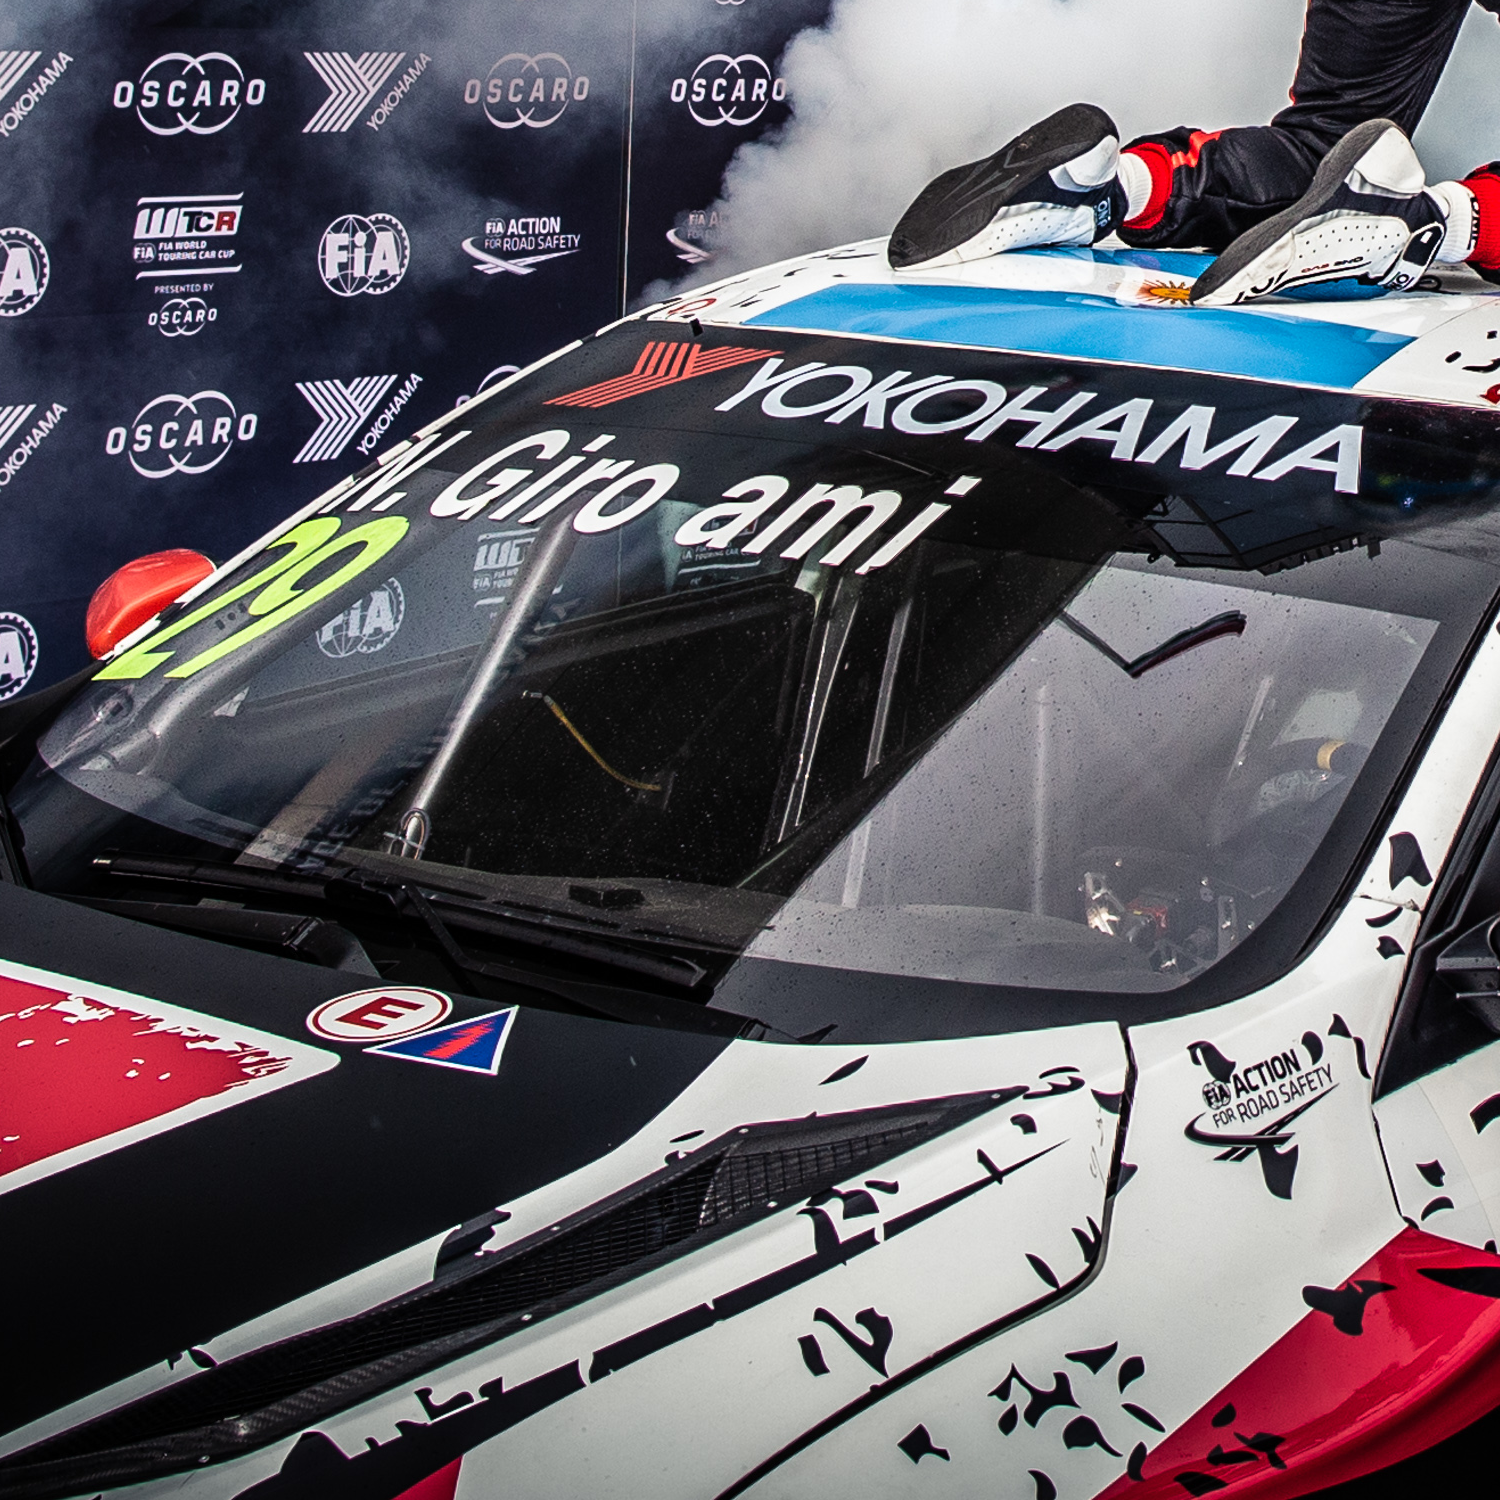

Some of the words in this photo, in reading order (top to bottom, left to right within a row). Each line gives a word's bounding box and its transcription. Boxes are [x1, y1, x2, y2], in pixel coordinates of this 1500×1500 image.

[113, 78, 267, 108] OSCARO
[365, 51, 433, 132] YOKOHAMA
[464, 76, 590, 105] OSCARO
[670, 77, 787, 102] OSCARO
[133, 205, 243, 239] WTCR
[507, 216, 561, 236] ACTION
[158, 242, 173, 252] FIA
[174, 240, 207, 251] WORLD
[158, 251, 197, 261] TOURING
[198, 250, 216, 260] CAR
[218, 248, 236, 259] CUP
[484, 237, 502, 250] FOR
[503, 236, 536, 252] ROAD
[537, 233, 581, 251] SAFETY
[154, 284, 201, 294] PRESENTED
[203, 283, 215, 292] BY
[148, 307, 218, 326] OSCARO
[356, 372, 423, 456] YOKOHAMA
[714, 358, 1365, 495] YOKOHAMA
[105, 412, 258, 457] OSCARO
[90, 515, 411, 682] 29
[1233, 1047, 1302, 1097] ACTION
[1212, 1106, 1236, 1129] FOR
[1236, 1090, 1282, 1122] ROAD
[1280, 1063, 1335, 1106] SAFETY
